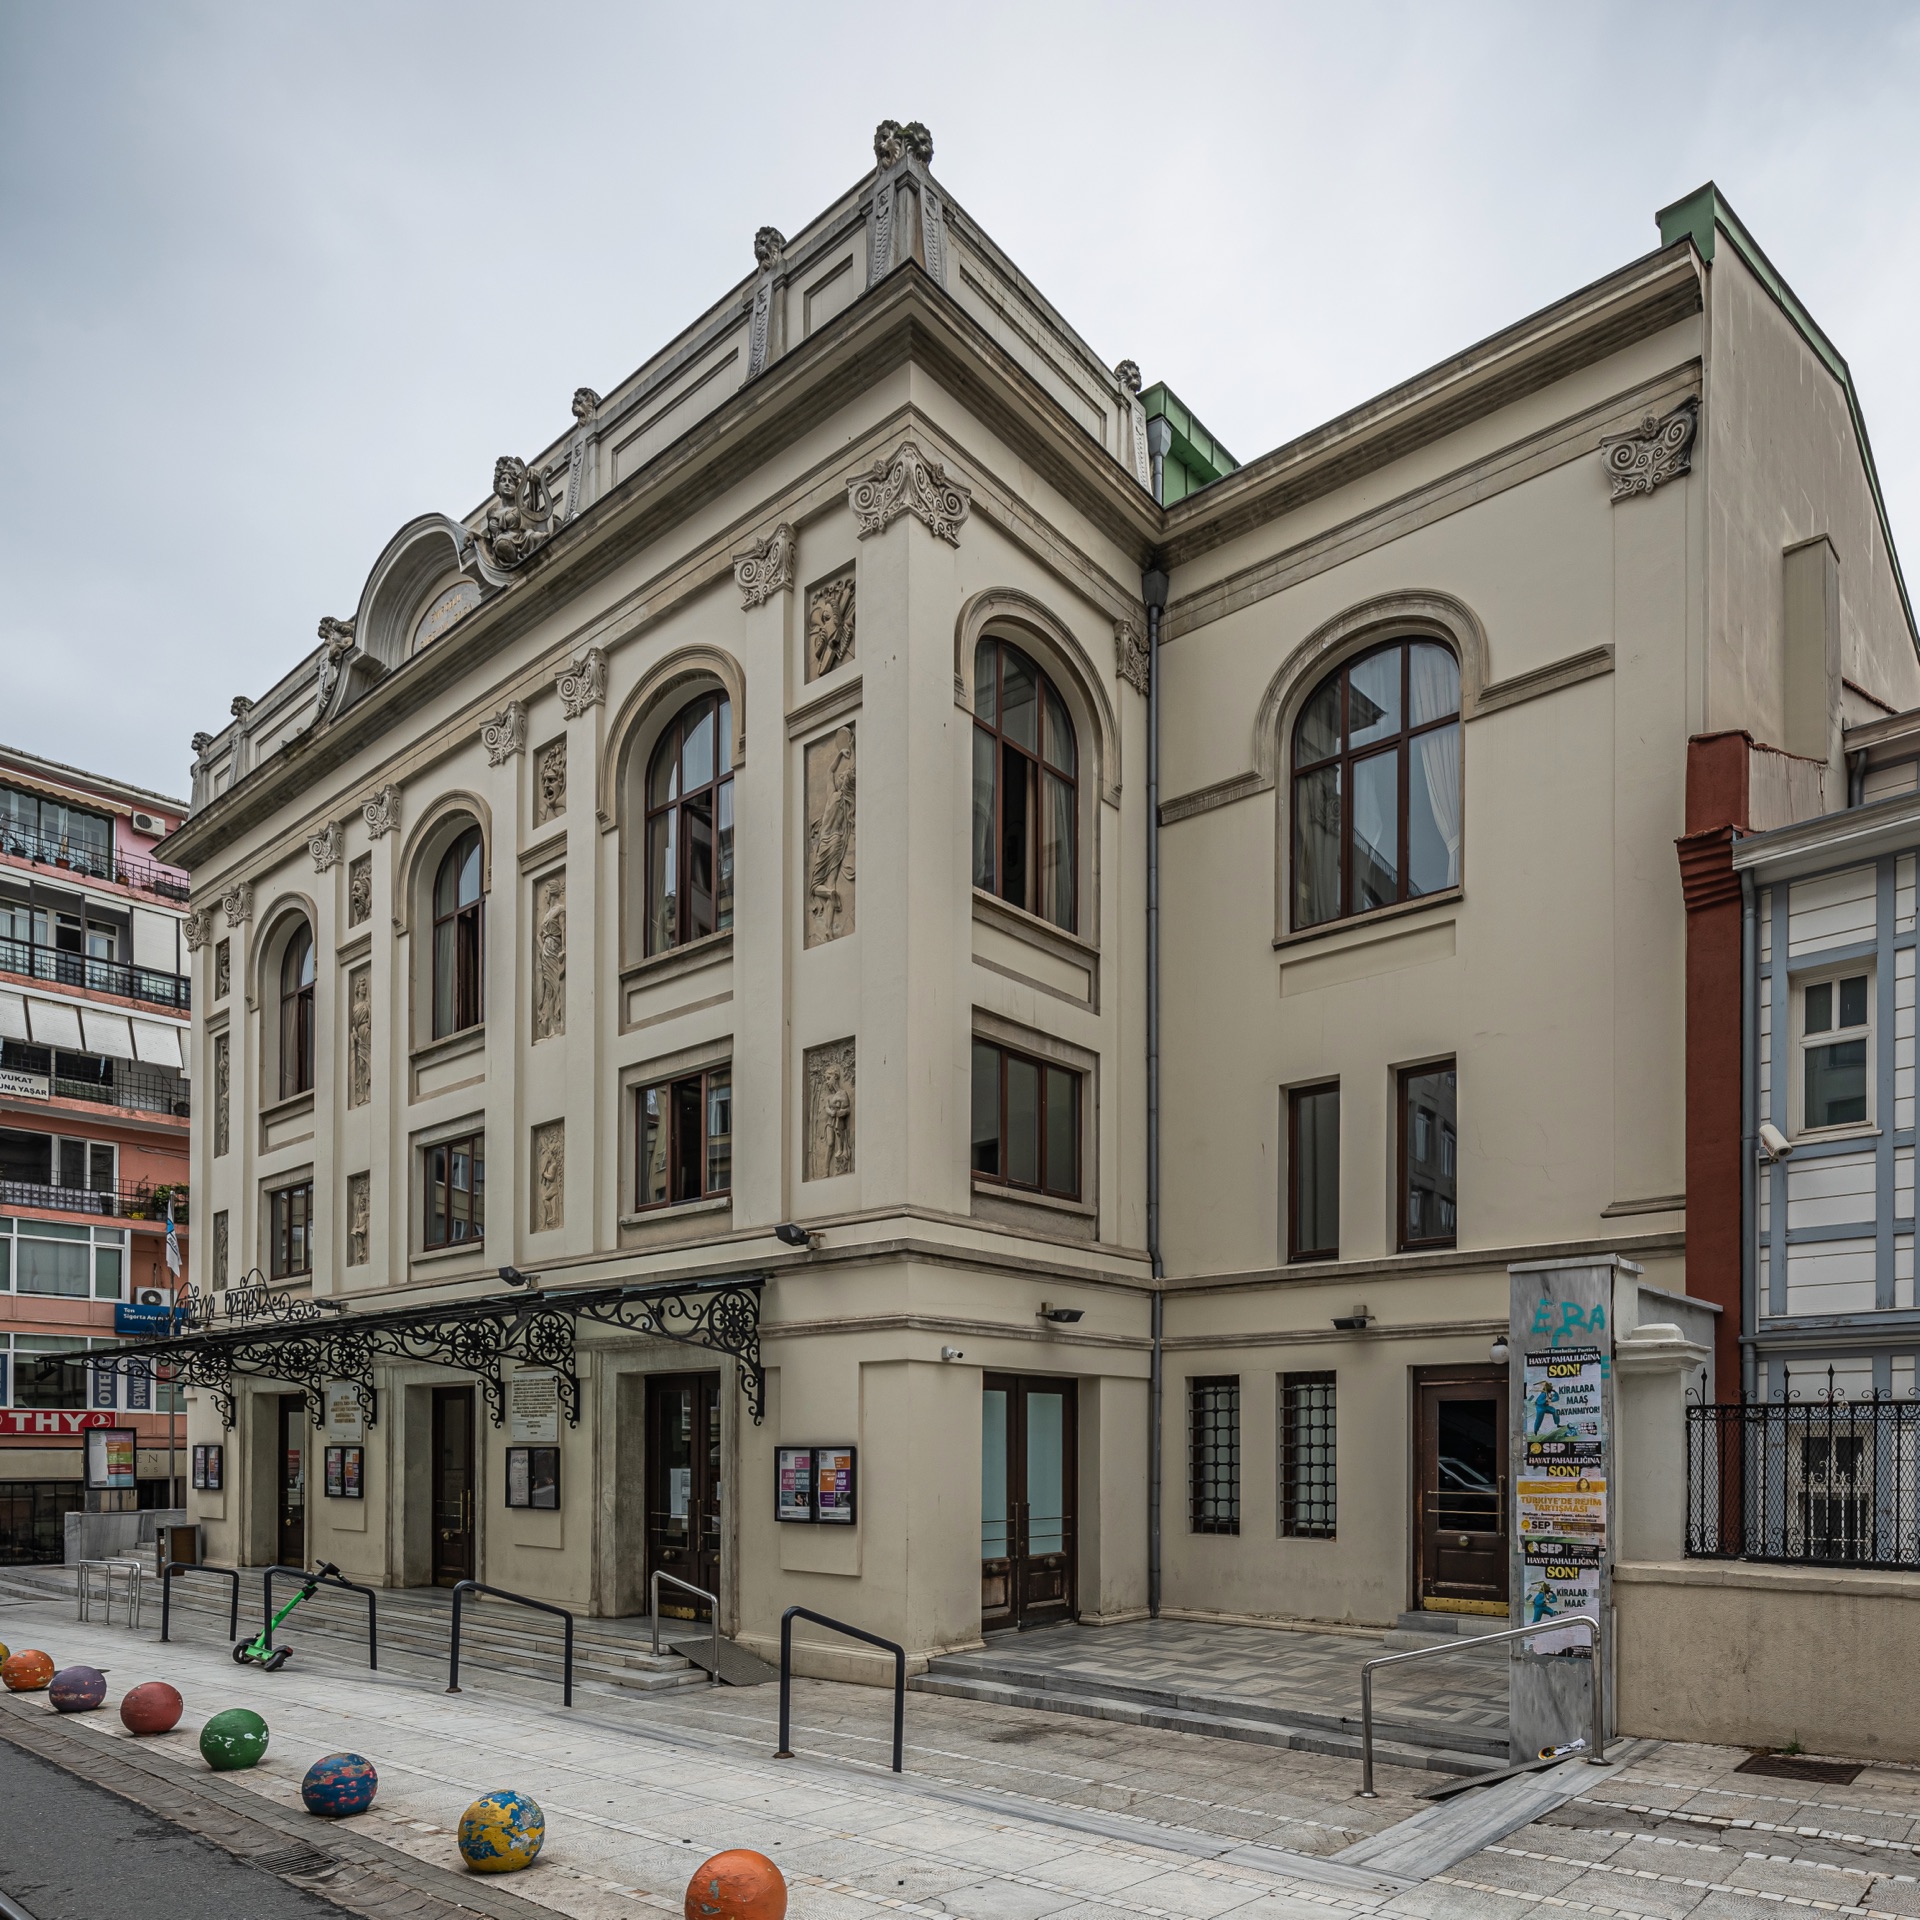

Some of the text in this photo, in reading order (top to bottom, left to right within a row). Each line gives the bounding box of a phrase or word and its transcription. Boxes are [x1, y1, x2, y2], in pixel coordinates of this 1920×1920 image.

[0, 1073, 33, 1084] VUKAT
[18, 1085, 47, 1096] YAŞAR
[1531, 1298, 1606, 1334] ERA
[1528, 1353, 1600, 1365] HAYAT PAHALILIĞINA
[1548, 1363, 1580, 1377] SON!
[1558, 1384, 1595, 1395] KİRALARA
[1566, 1395, 1589, 1406] MAAŞ
[1556, 1405, 1600, 1416] DAYANMIYOR!
[8, 1412, 88, 1432] THY
[1542, 1442, 1566, 1454] SEP
[1551, 1456, 1600, 1464] PAHALILIĞINA
[1548, 1465, 1580, 1477] SON!
[1531, 1520, 1551, 1530] SEP
[1540, 1543, 1563, 1554] SEP
[1527, 1557, 1598, 1566] HAYAT PAHALILIĞINA
[1546, 1566, 1578, 1579] SON!
[1556, 1587, 1588, 1597] KİRALAR
